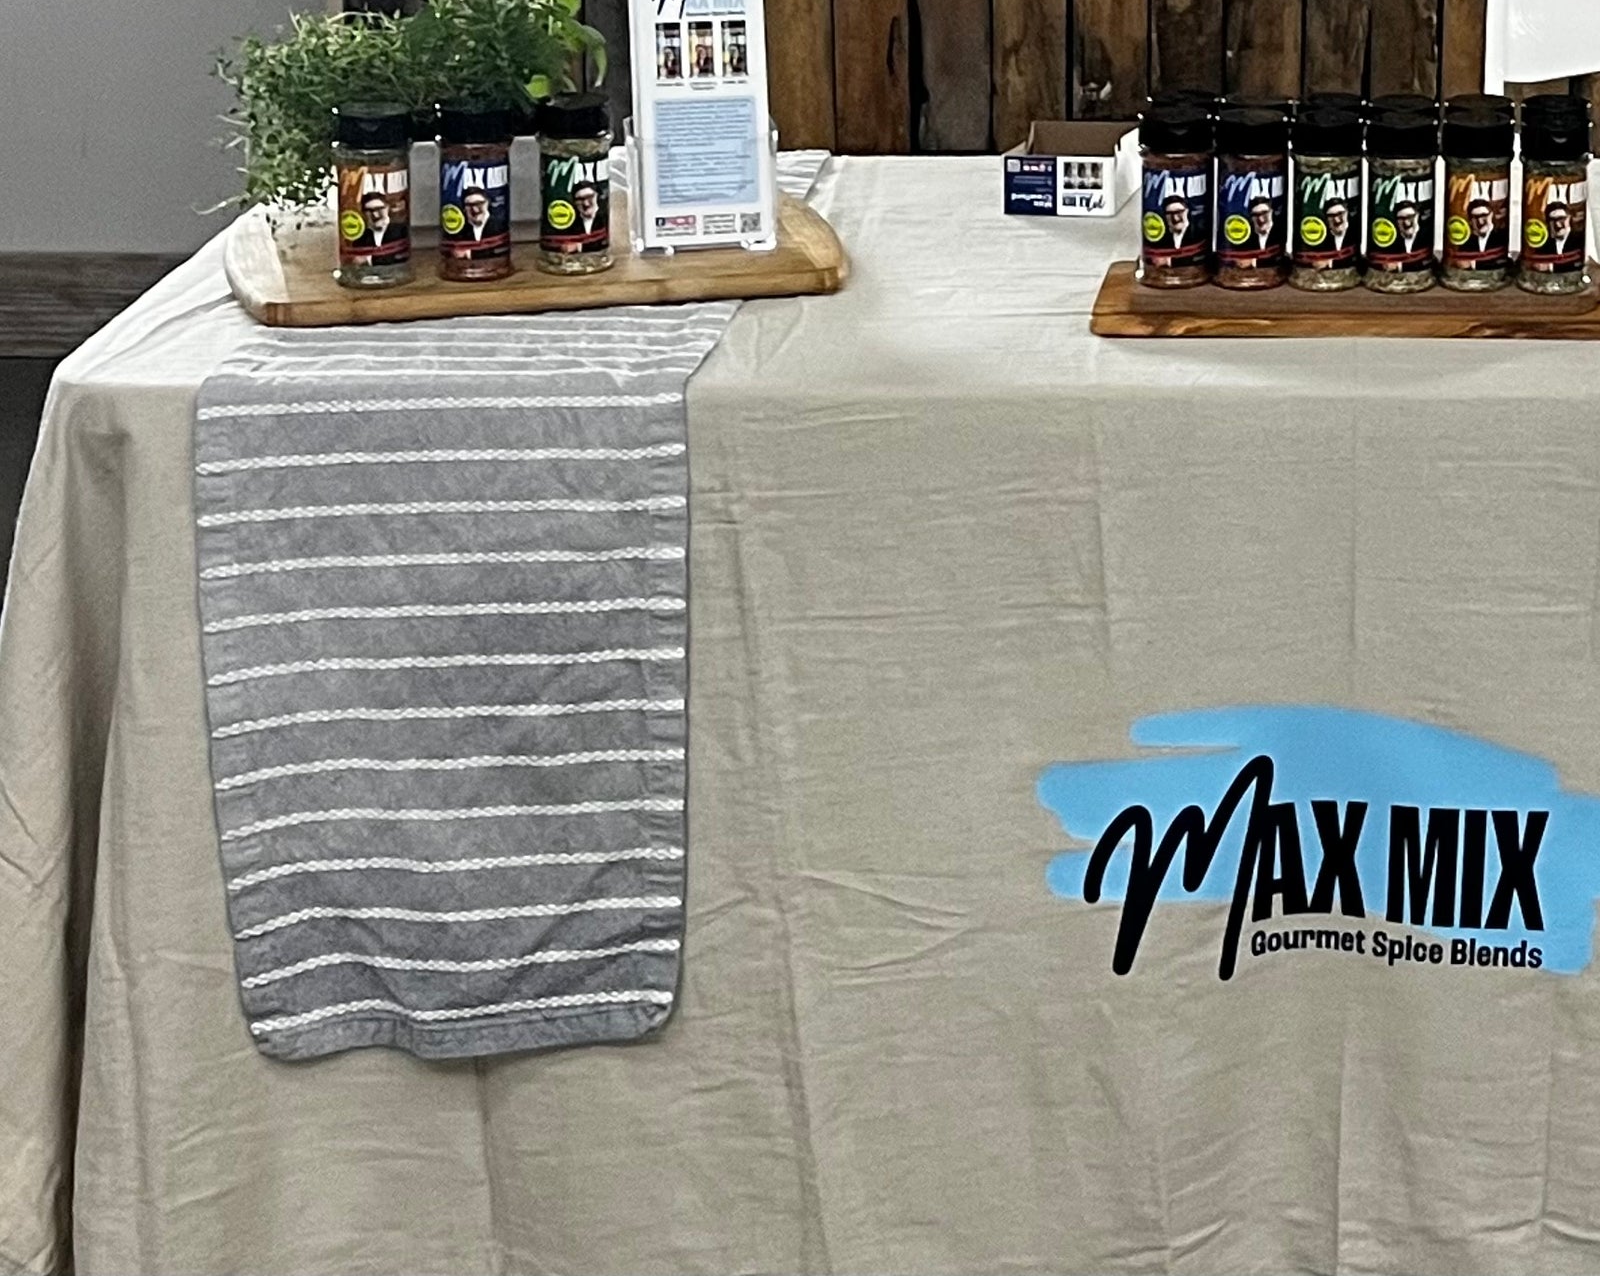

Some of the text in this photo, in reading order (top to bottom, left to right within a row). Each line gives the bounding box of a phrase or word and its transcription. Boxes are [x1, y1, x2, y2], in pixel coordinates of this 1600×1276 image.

[341, 166, 386, 203] MAX
[442, 160, 485, 198] MAX
[547, 155, 596, 193] MAX
[1145, 170, 1185, 206] MAX
[1225, 171, 1270, 208] MAX
[1301, 173, 1346, 210] MAX
[1373, 175, 1417, 212] MAX
[1449, 174, 1491, 212] MAX
[1526, 177, 1570, 213] MAX
[1083, 755, 1550, 981] MAX MIX
[1250, 929, 1543, 969] Gourmet Spice Blends
